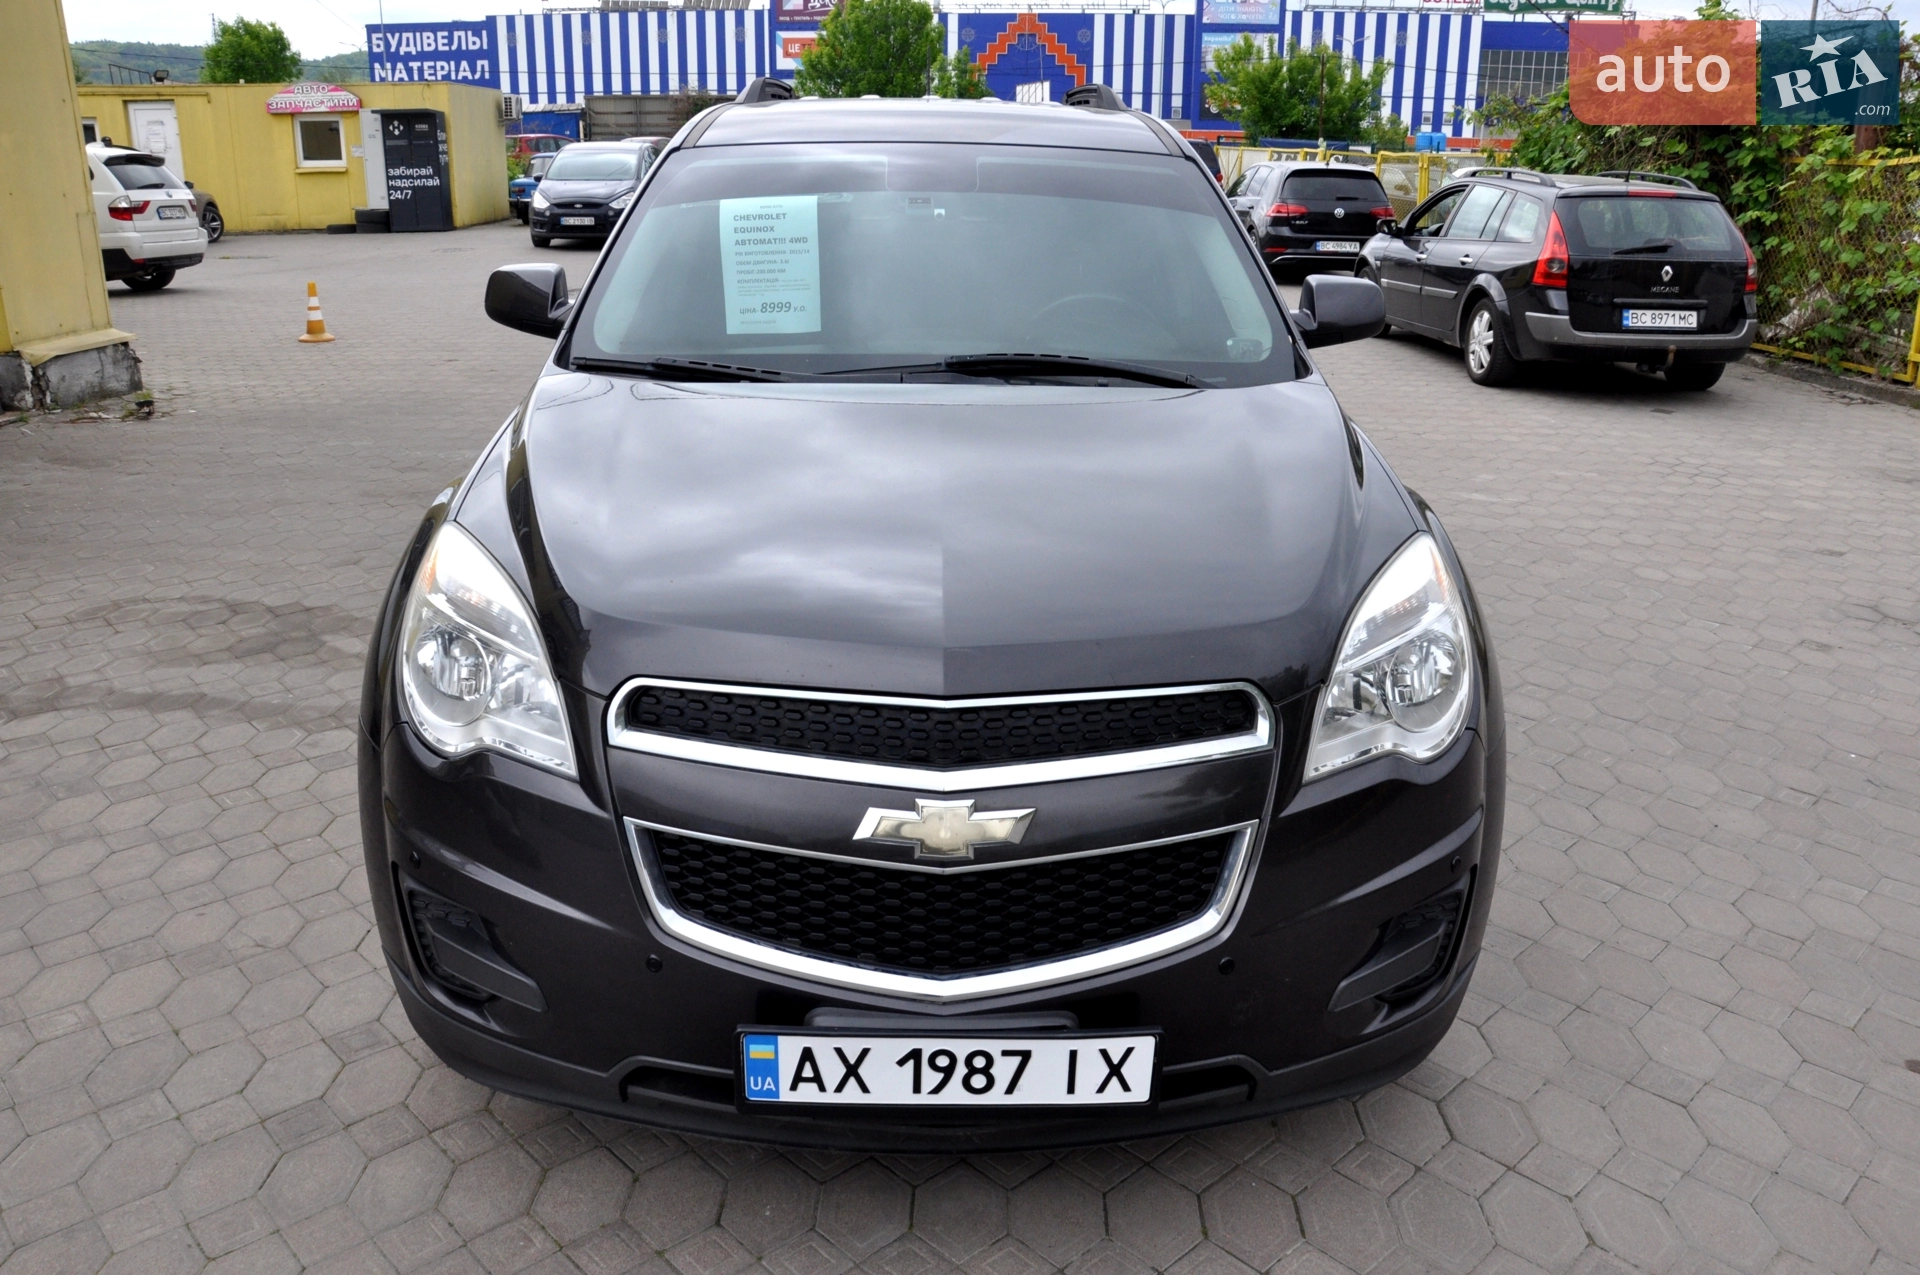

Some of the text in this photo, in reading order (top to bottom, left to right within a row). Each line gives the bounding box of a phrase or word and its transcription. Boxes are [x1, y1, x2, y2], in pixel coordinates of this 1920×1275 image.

[294, 84, 329, 94] АВТО
[268, 98, 357, 109] ЗАПЧАСТИНИ
[387, 166, 433, 177] забирай
[388, 177, 440, 187] надсилай
[389, 190, 412, 200] 24/7
[733, 213, 787, 222] CHEVROLET
[733, 225, 775, 234] EQUINOX
[734, 236, 808, 246] АВТОМАТ!!! 4WD
[739, 307, 759, 315] ЦІНА-
[760, 301, 792, 314] 8999
[1630, 312, 1694, 326] BC 8971 MC
[788, 1045, 1136, 1095] AX 1987 IX
[750, 1075, 776, 1092] UA
